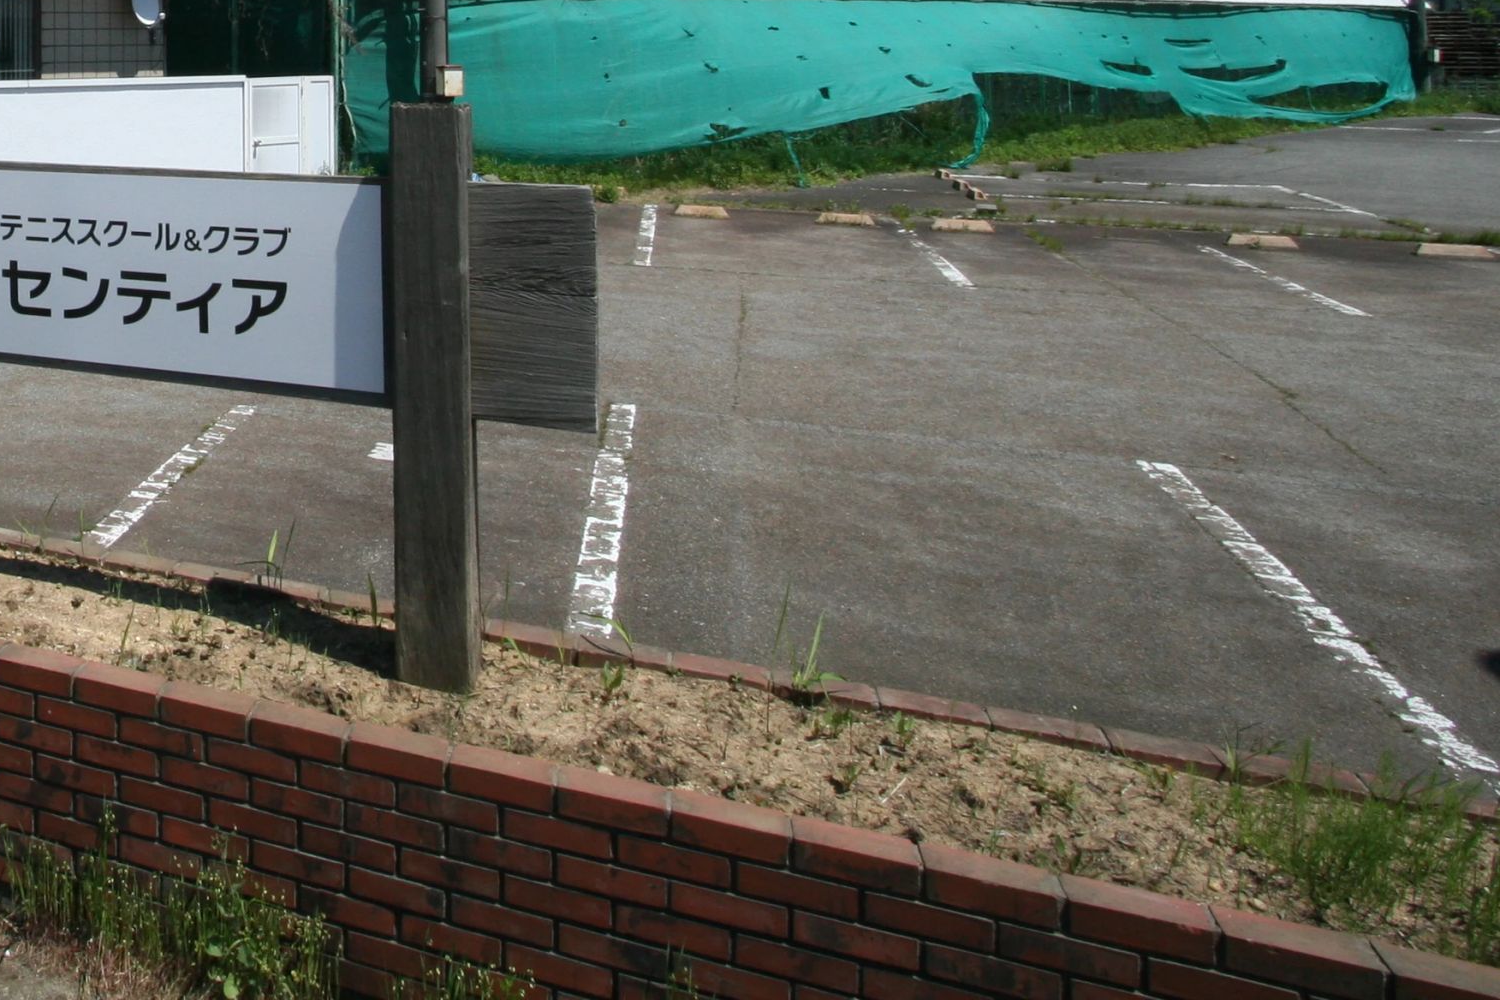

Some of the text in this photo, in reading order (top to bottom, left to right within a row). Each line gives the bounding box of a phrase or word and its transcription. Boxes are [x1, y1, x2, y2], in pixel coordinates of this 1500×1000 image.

[0, 214, 292, 258] テニススクール&クラブ
[1, 259, 288, 335] センティア
